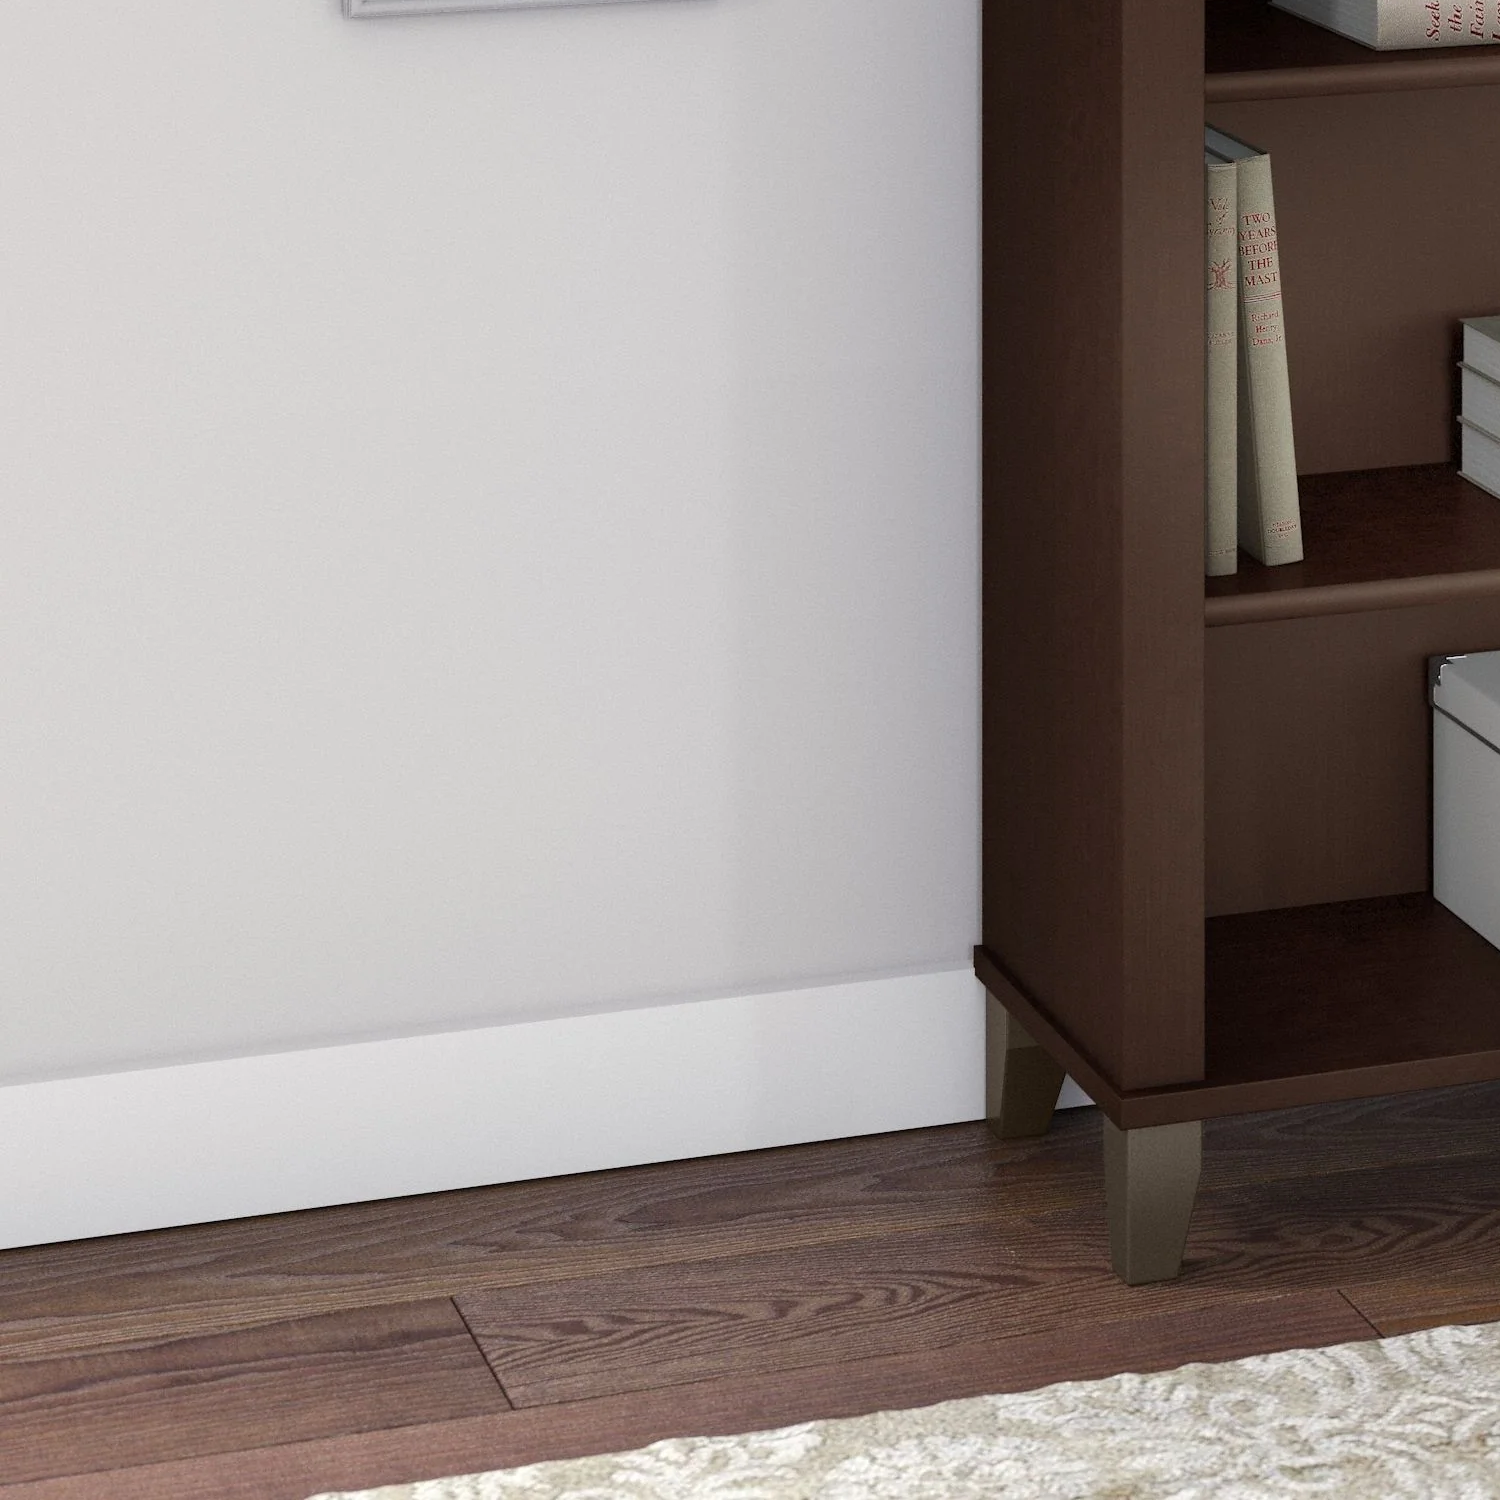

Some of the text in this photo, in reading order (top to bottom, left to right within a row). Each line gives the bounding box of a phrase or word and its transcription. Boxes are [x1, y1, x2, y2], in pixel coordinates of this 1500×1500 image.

[1424, 0, 1442, 42] Seek
[1447, 4, 1463, 33] the
[1241, 212, 1271, 226] TWO
[1238, 225, 1277, 242] YEARS
[1247, 256, 1274, 271] THE
[1244, 271, 1278, 287] MAST
